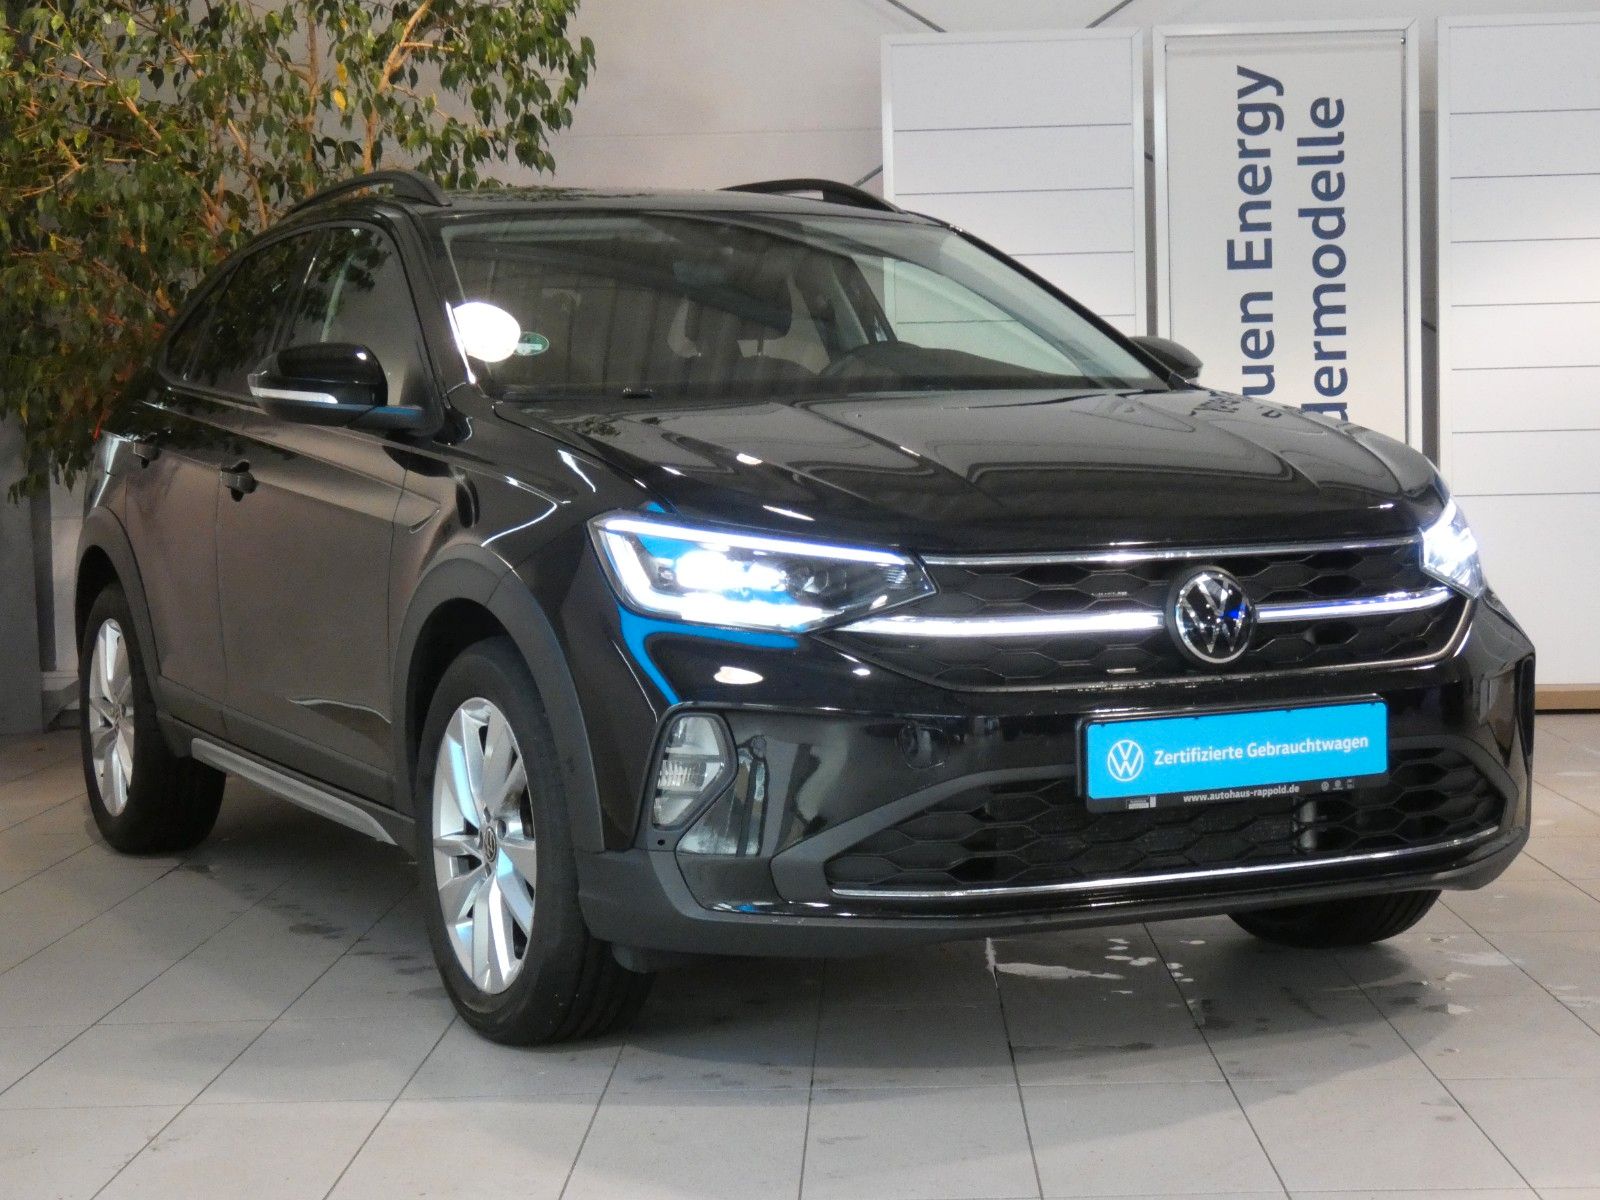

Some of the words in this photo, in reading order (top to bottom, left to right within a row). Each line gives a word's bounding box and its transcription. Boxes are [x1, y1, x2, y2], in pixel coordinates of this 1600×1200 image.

[1227, 65, 1284, 270] Energy
[1107, 740, 1144, 782] VW
[1154, 745, 1243, 766] Zertifizierte
[1247, 735, 1369, 758] Gebrauchtwagen
[1183, 784, 1300, 802] www.autohaus-rappold.de
